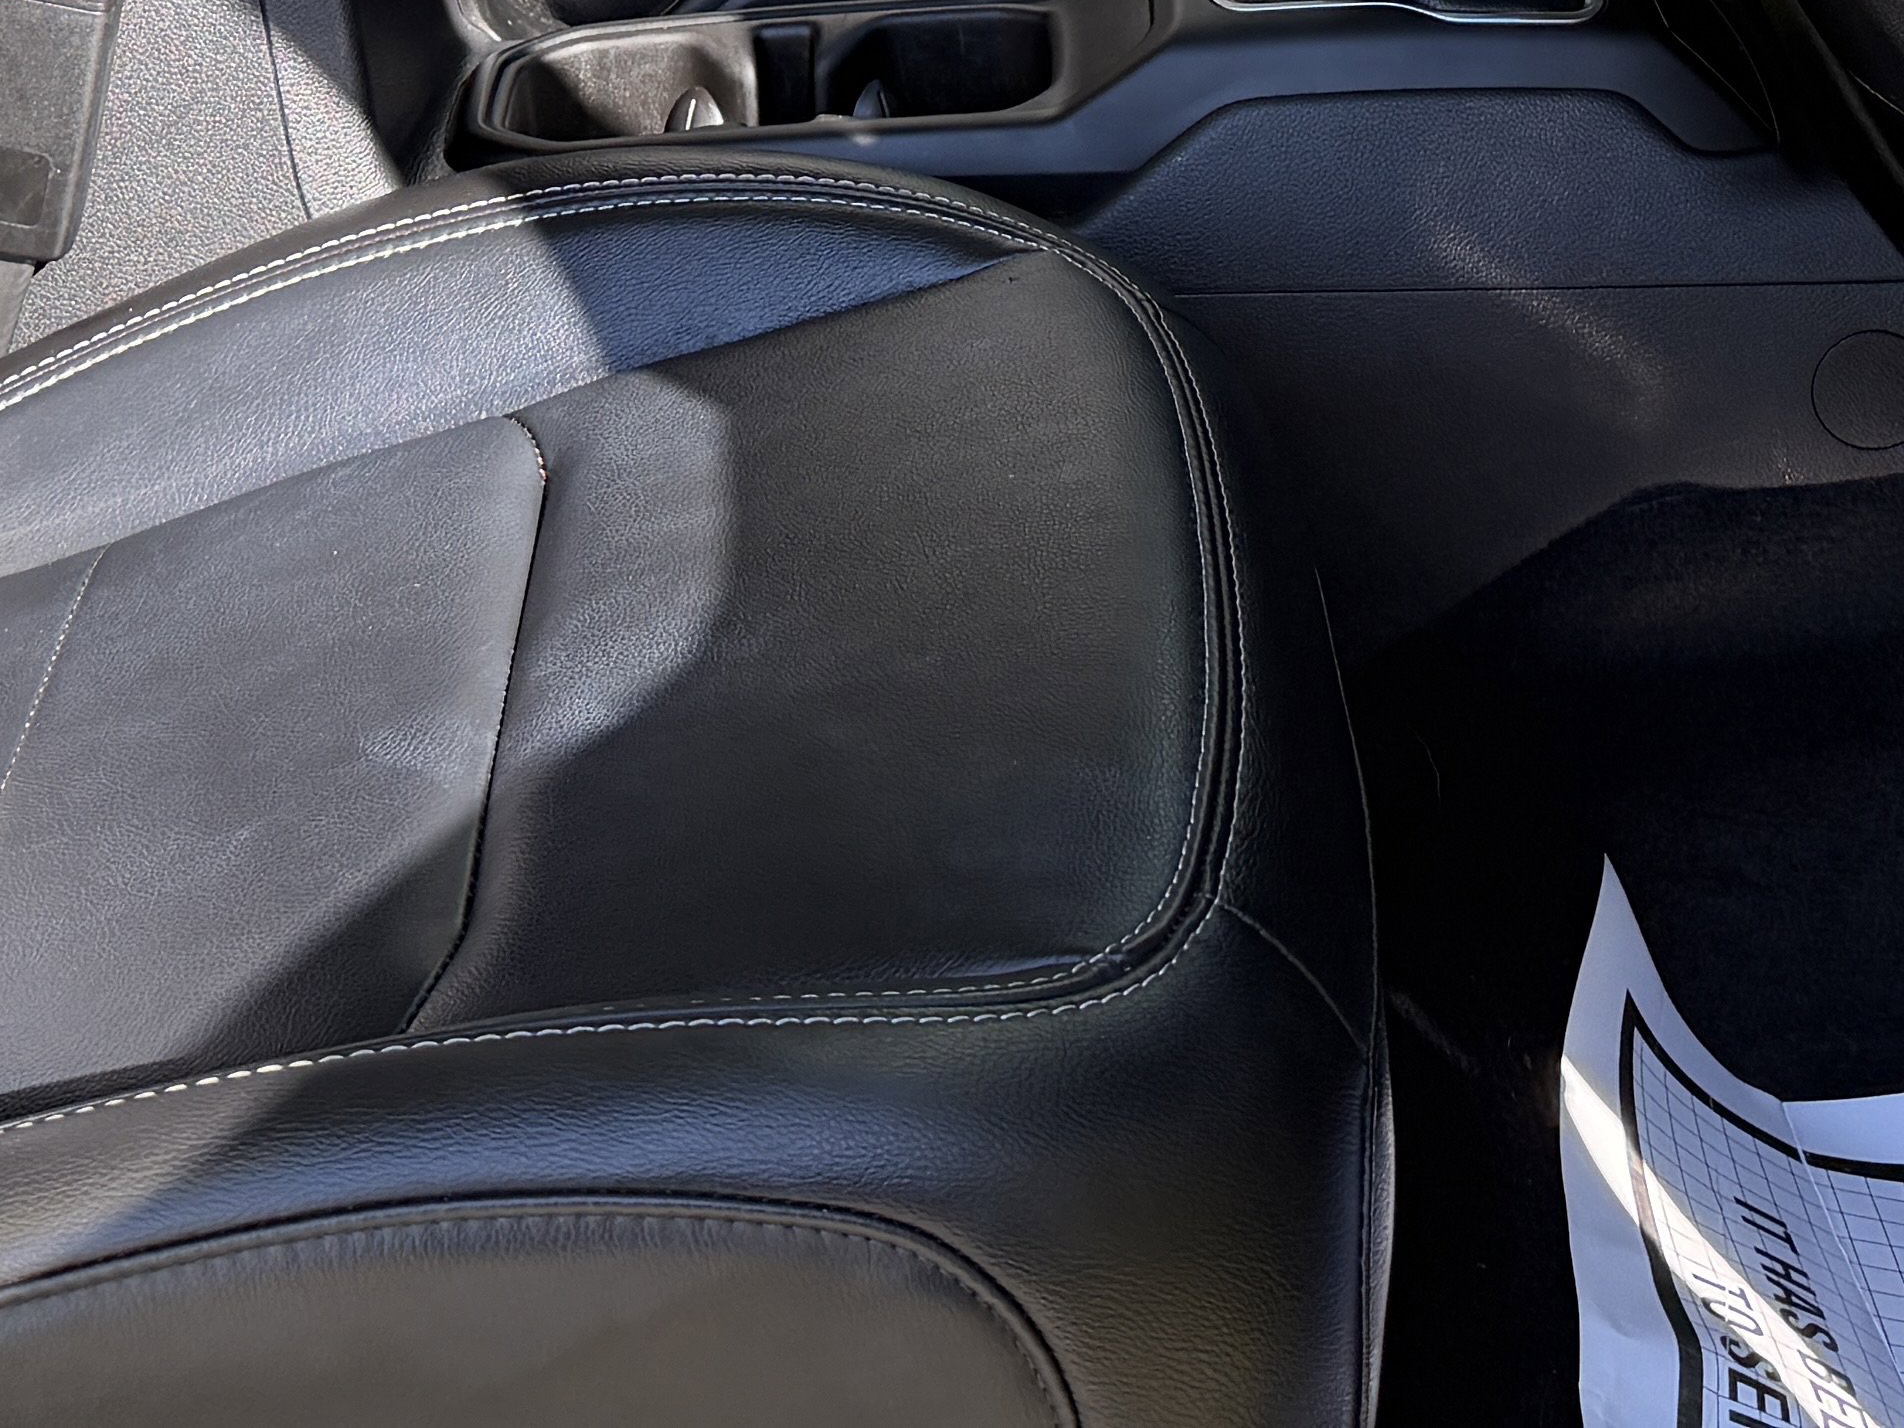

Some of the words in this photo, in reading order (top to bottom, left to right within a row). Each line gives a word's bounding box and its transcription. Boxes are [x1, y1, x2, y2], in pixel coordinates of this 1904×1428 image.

[1733, 1196, 1800, 1257] IT
[1692, 1273, 1764, 1337] TO
[1753, 1246, 1839, 1353] HAS
[1720, 1334, 1791, 1428] SE
